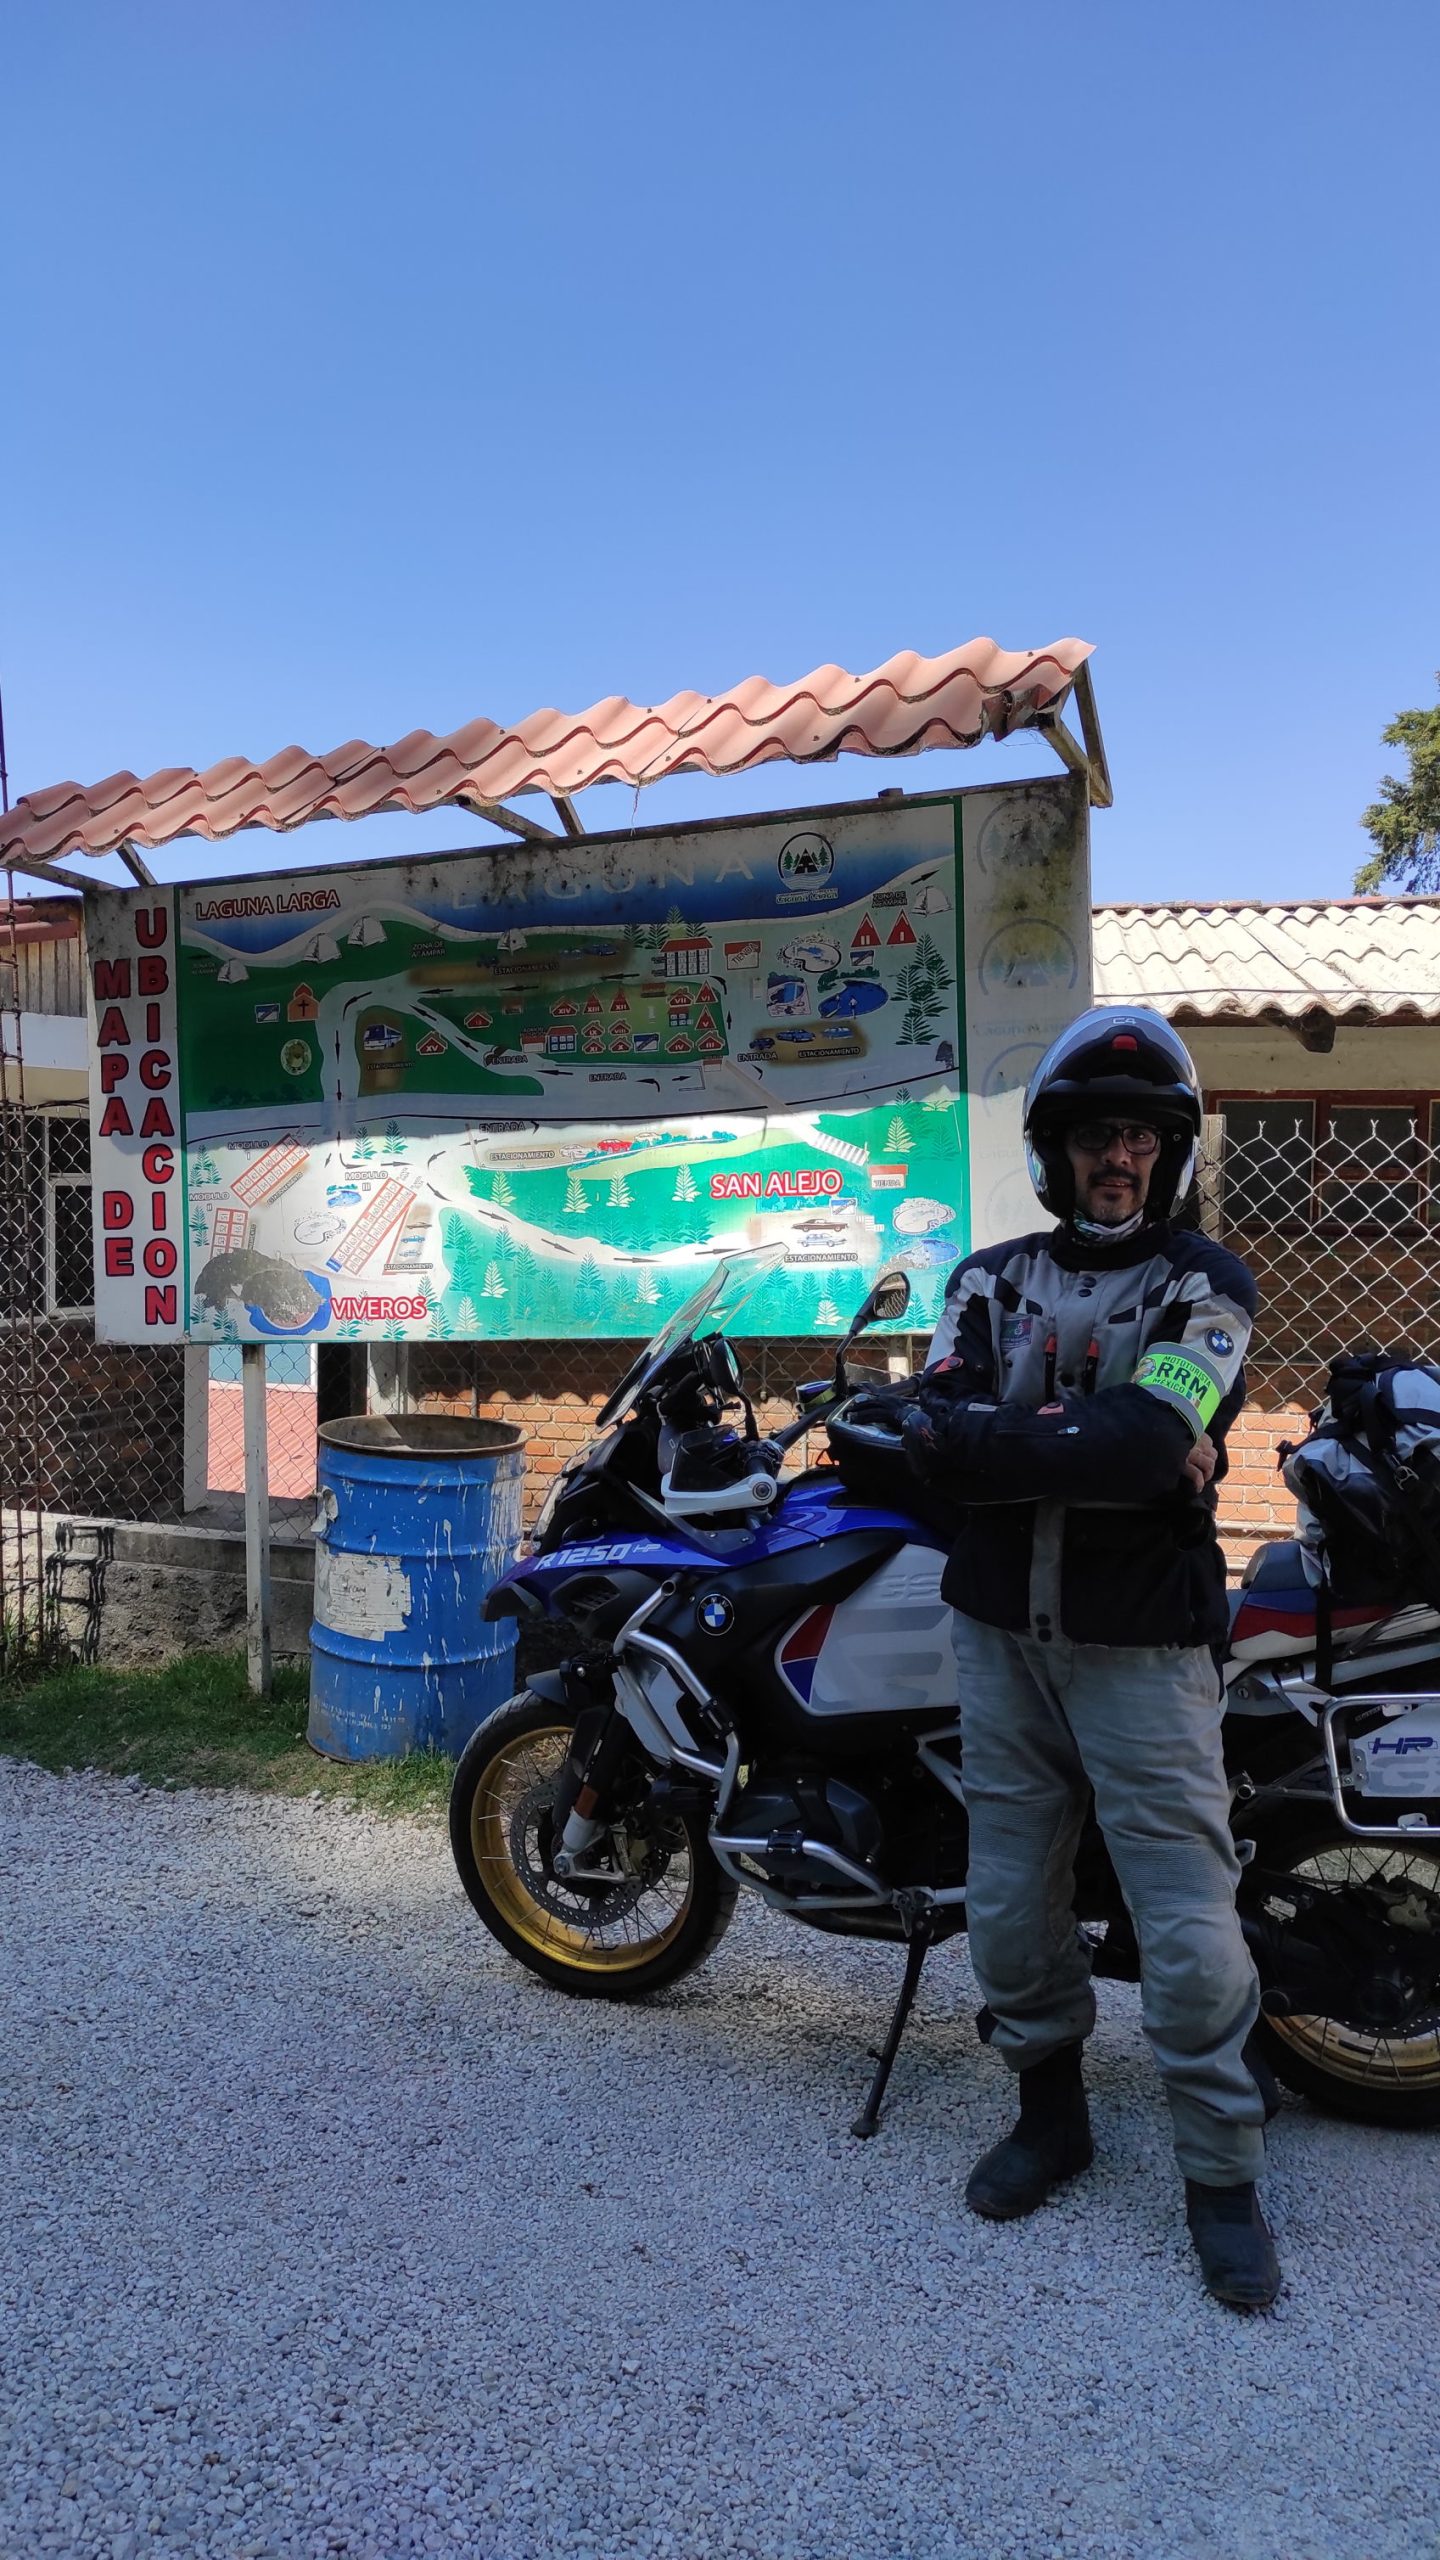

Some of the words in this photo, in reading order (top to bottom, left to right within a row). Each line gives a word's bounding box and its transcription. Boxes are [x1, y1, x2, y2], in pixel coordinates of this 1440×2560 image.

[895, 890, 906, 899] DE
[196, 897, 277, 921] LAGUNA
[277, 889, 341, 913] LARGA
[1111, 1017, 1137, 1026] C4
[93, 957, 134, 1137] MAPA
[425, 1044, 440, 1052] XV
[798, 1047, 861, 1058] ESTACIONAMIENTO
[491, 1054, 529, 1066] ENTRADA
[738, 1051, 778, 1062] ENTRADA
[588, 1072, 627, 1083] ENTRADA
[134, 906, 178, 1326] UBICACION
[479, 1121, 526, 1133] ENTRADA
[228, 1140, 270, 1150] MODULO
[489, 1150, 555, 1161] ESTACIONAMIENTO
[344, 1170, 389, 1181] MODULO
[710, 1172, 762, 1199] SAN
[765, 1169, 843, 1197] ALEJO
[188, 1191, 231, 1201] MODULO
[102, 1190, 135, 1278] DE
[784, 1253, 858, 1263] ESTACIONAMIENTO
[330, 1296, 427, 1321] VIVEROS
[1162, 1355, 1212, 1388] MOTOTURISTA
[1152, 1378, 1185, 1394] MÉXICO
[1156, 1361, 1209, 1402] RRM
[632, 1543, 664, 1554] HP
[1369, 1737, 1436, 1755] HP
